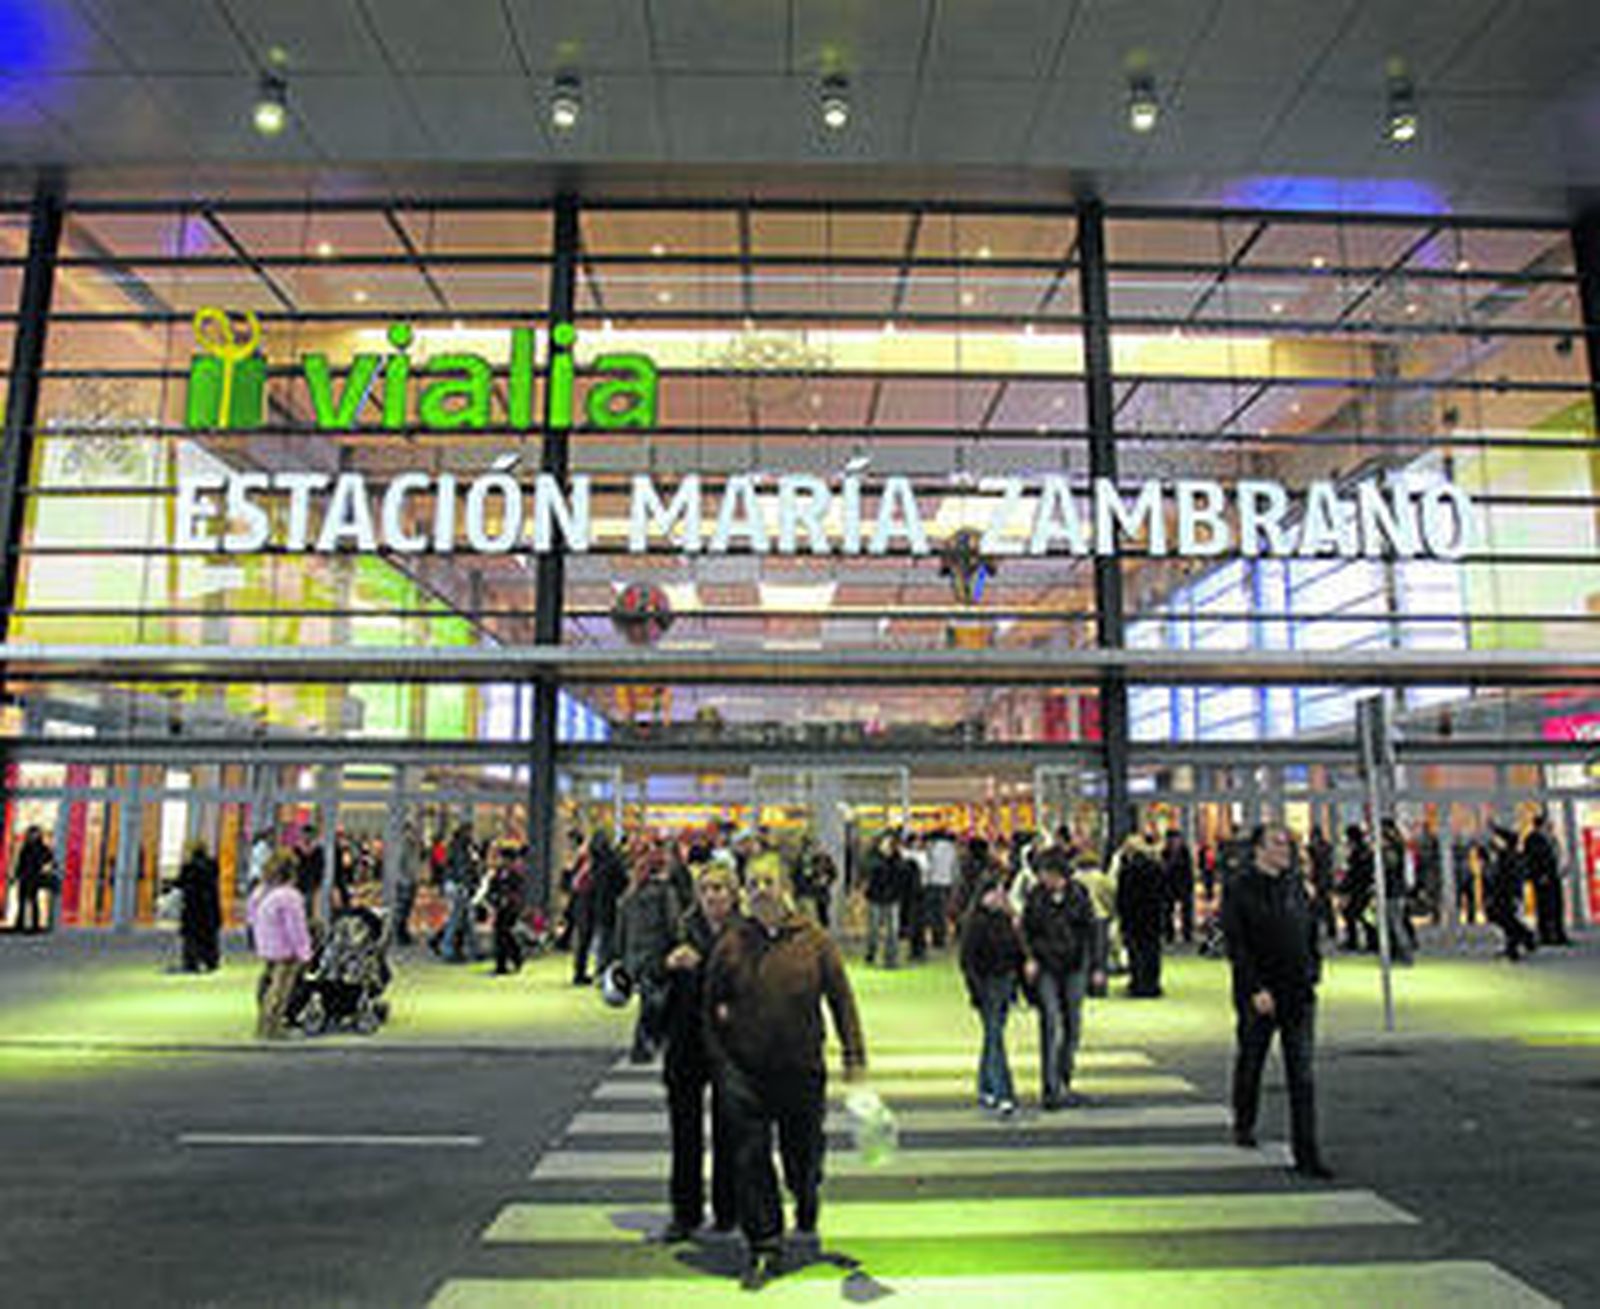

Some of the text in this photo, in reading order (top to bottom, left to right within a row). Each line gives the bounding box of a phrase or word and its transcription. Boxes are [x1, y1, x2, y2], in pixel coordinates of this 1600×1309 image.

[304, 322, 659, 429] vialia
[174, 453, 1474, 559] ESTACIÓN MARÍA ZAMBRANO
